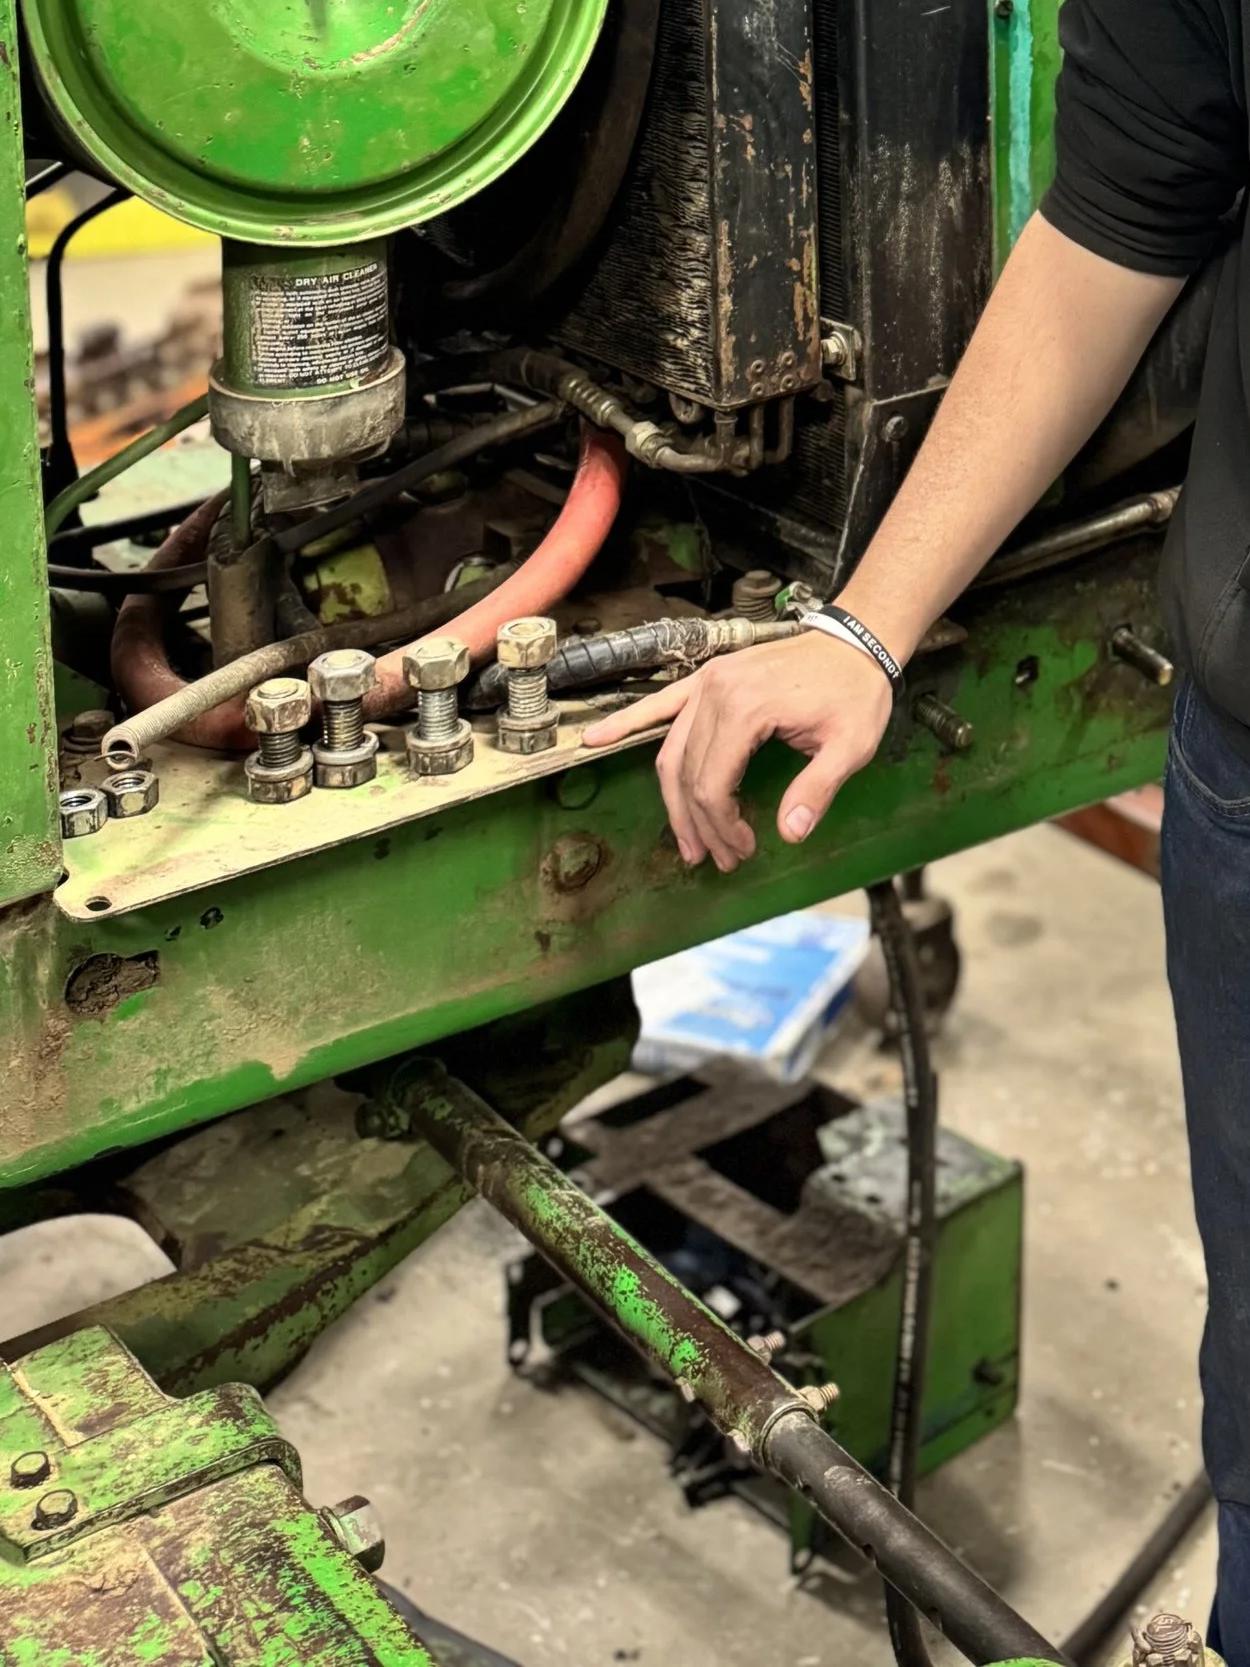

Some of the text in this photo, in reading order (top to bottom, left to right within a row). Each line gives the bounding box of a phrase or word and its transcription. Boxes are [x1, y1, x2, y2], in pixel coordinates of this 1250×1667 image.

[295, 263, 378, 287] DRY AIR CLEANER
[329, 374, 344, 382] NOT
[848, 620, 864, 635] AM
[862, 633, 896, 673] SECOND
